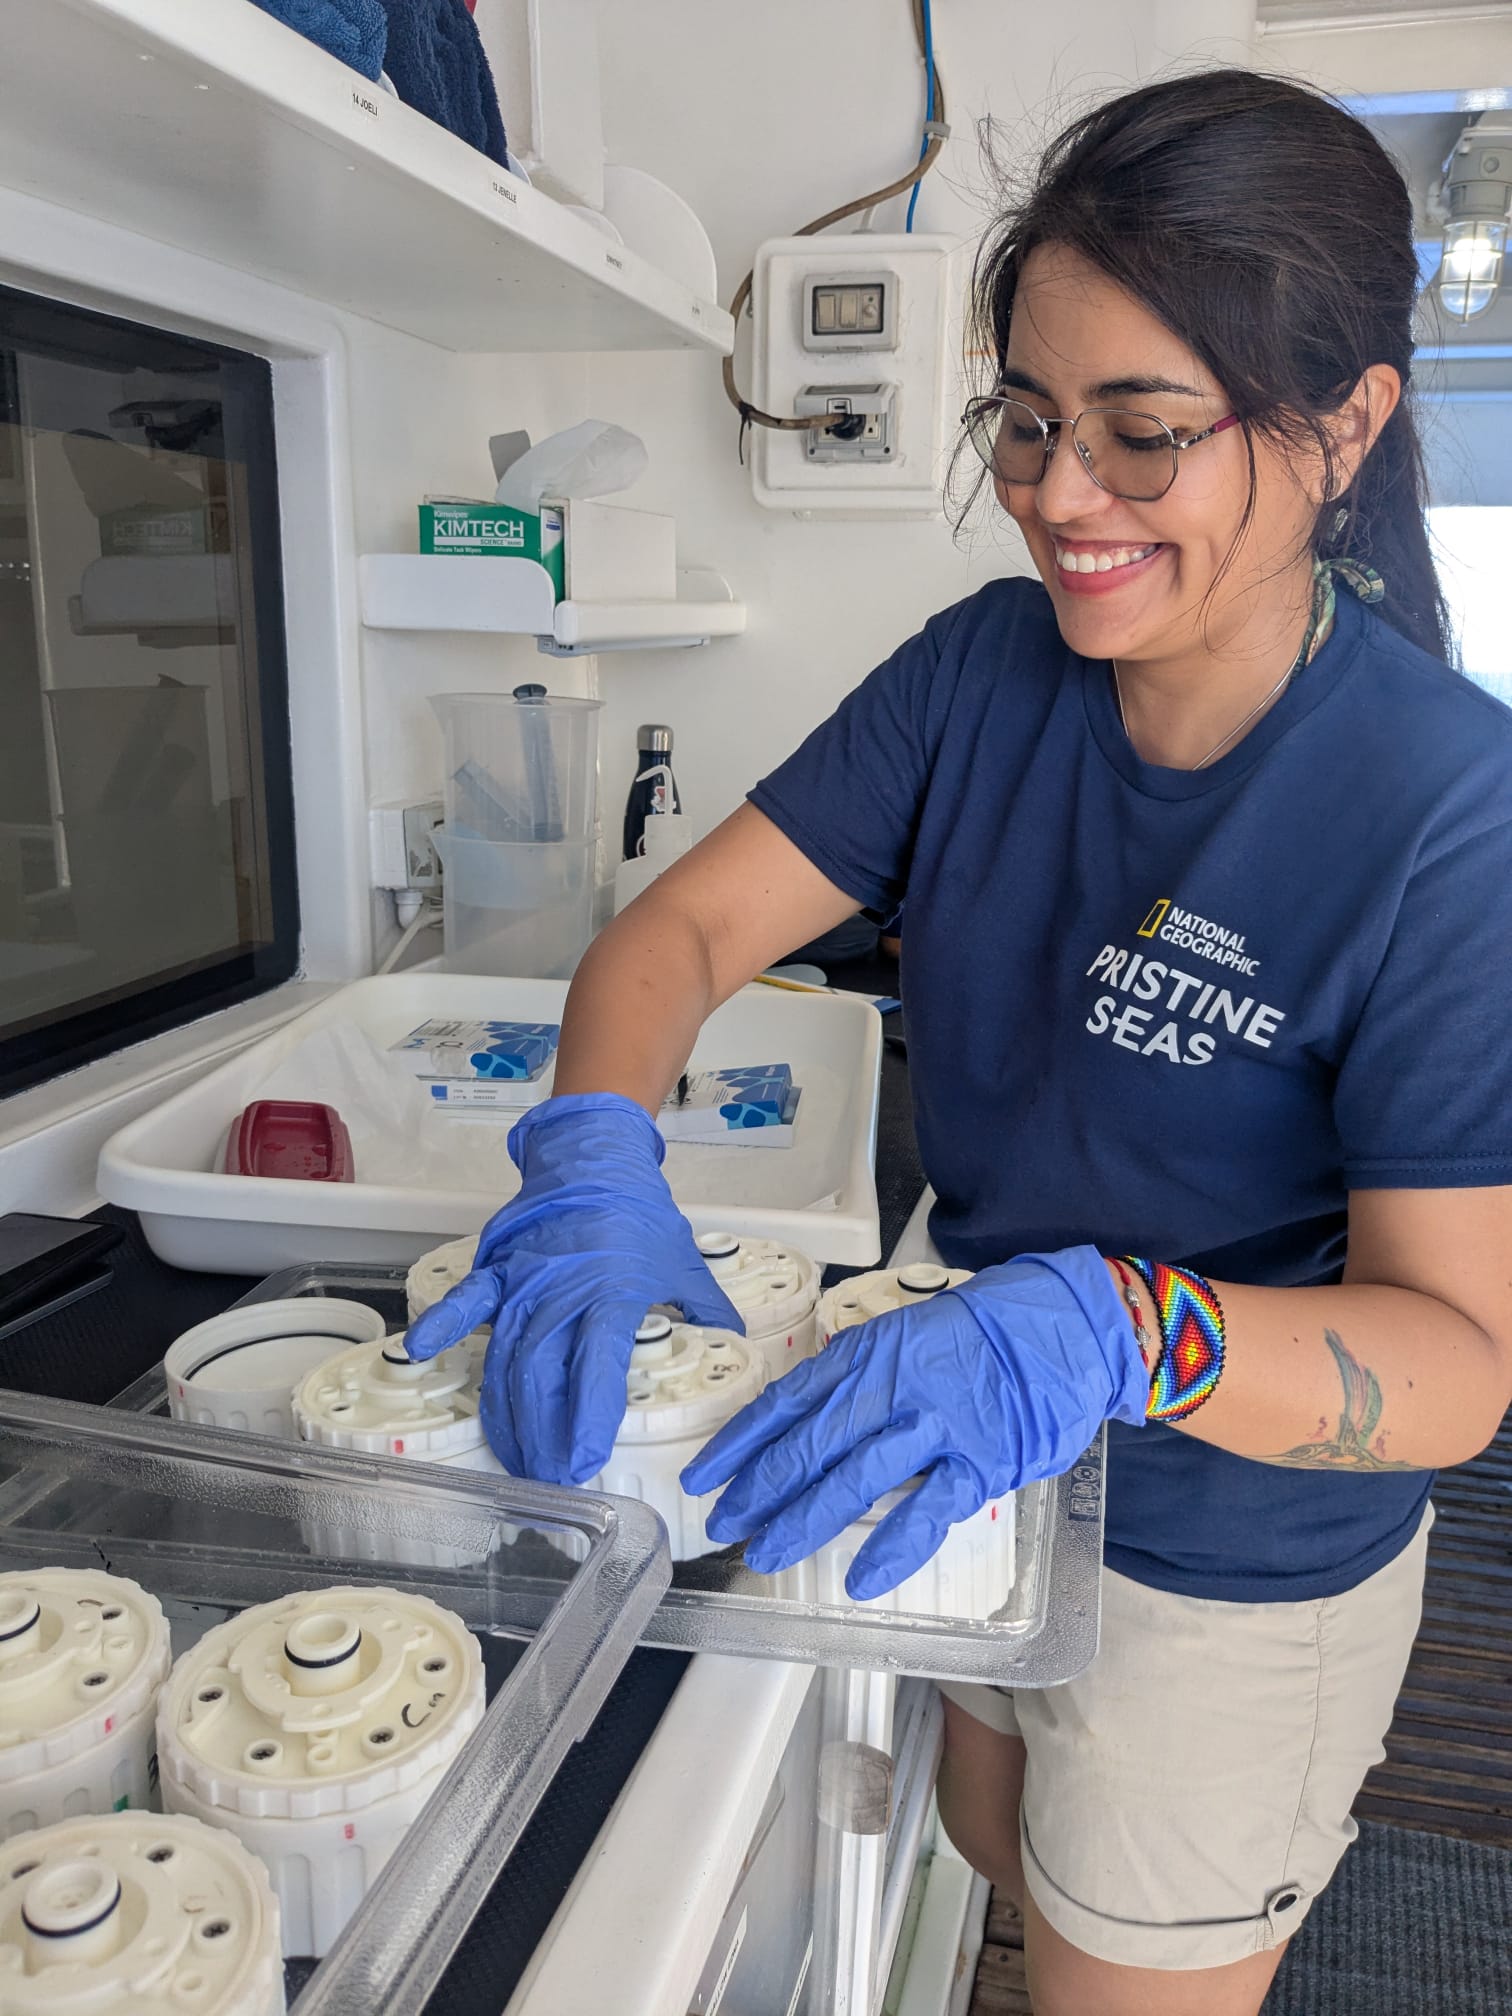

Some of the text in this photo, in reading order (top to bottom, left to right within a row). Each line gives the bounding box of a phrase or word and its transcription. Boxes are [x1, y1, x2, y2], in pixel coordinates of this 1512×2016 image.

[360, 98, 378, 117] JOELI
[434, 520, 524, 537] KIMTECH
[480, 538, 504, 546] SCIENCE
[1159, 924, 1262, 977] GEOGRAPHIC
[1168, 906, 1246, 953] NATIONAL
[1086, 944, 1286, 1049] PRISTINE
[1085, 995, 1217, 1066] SEAS
